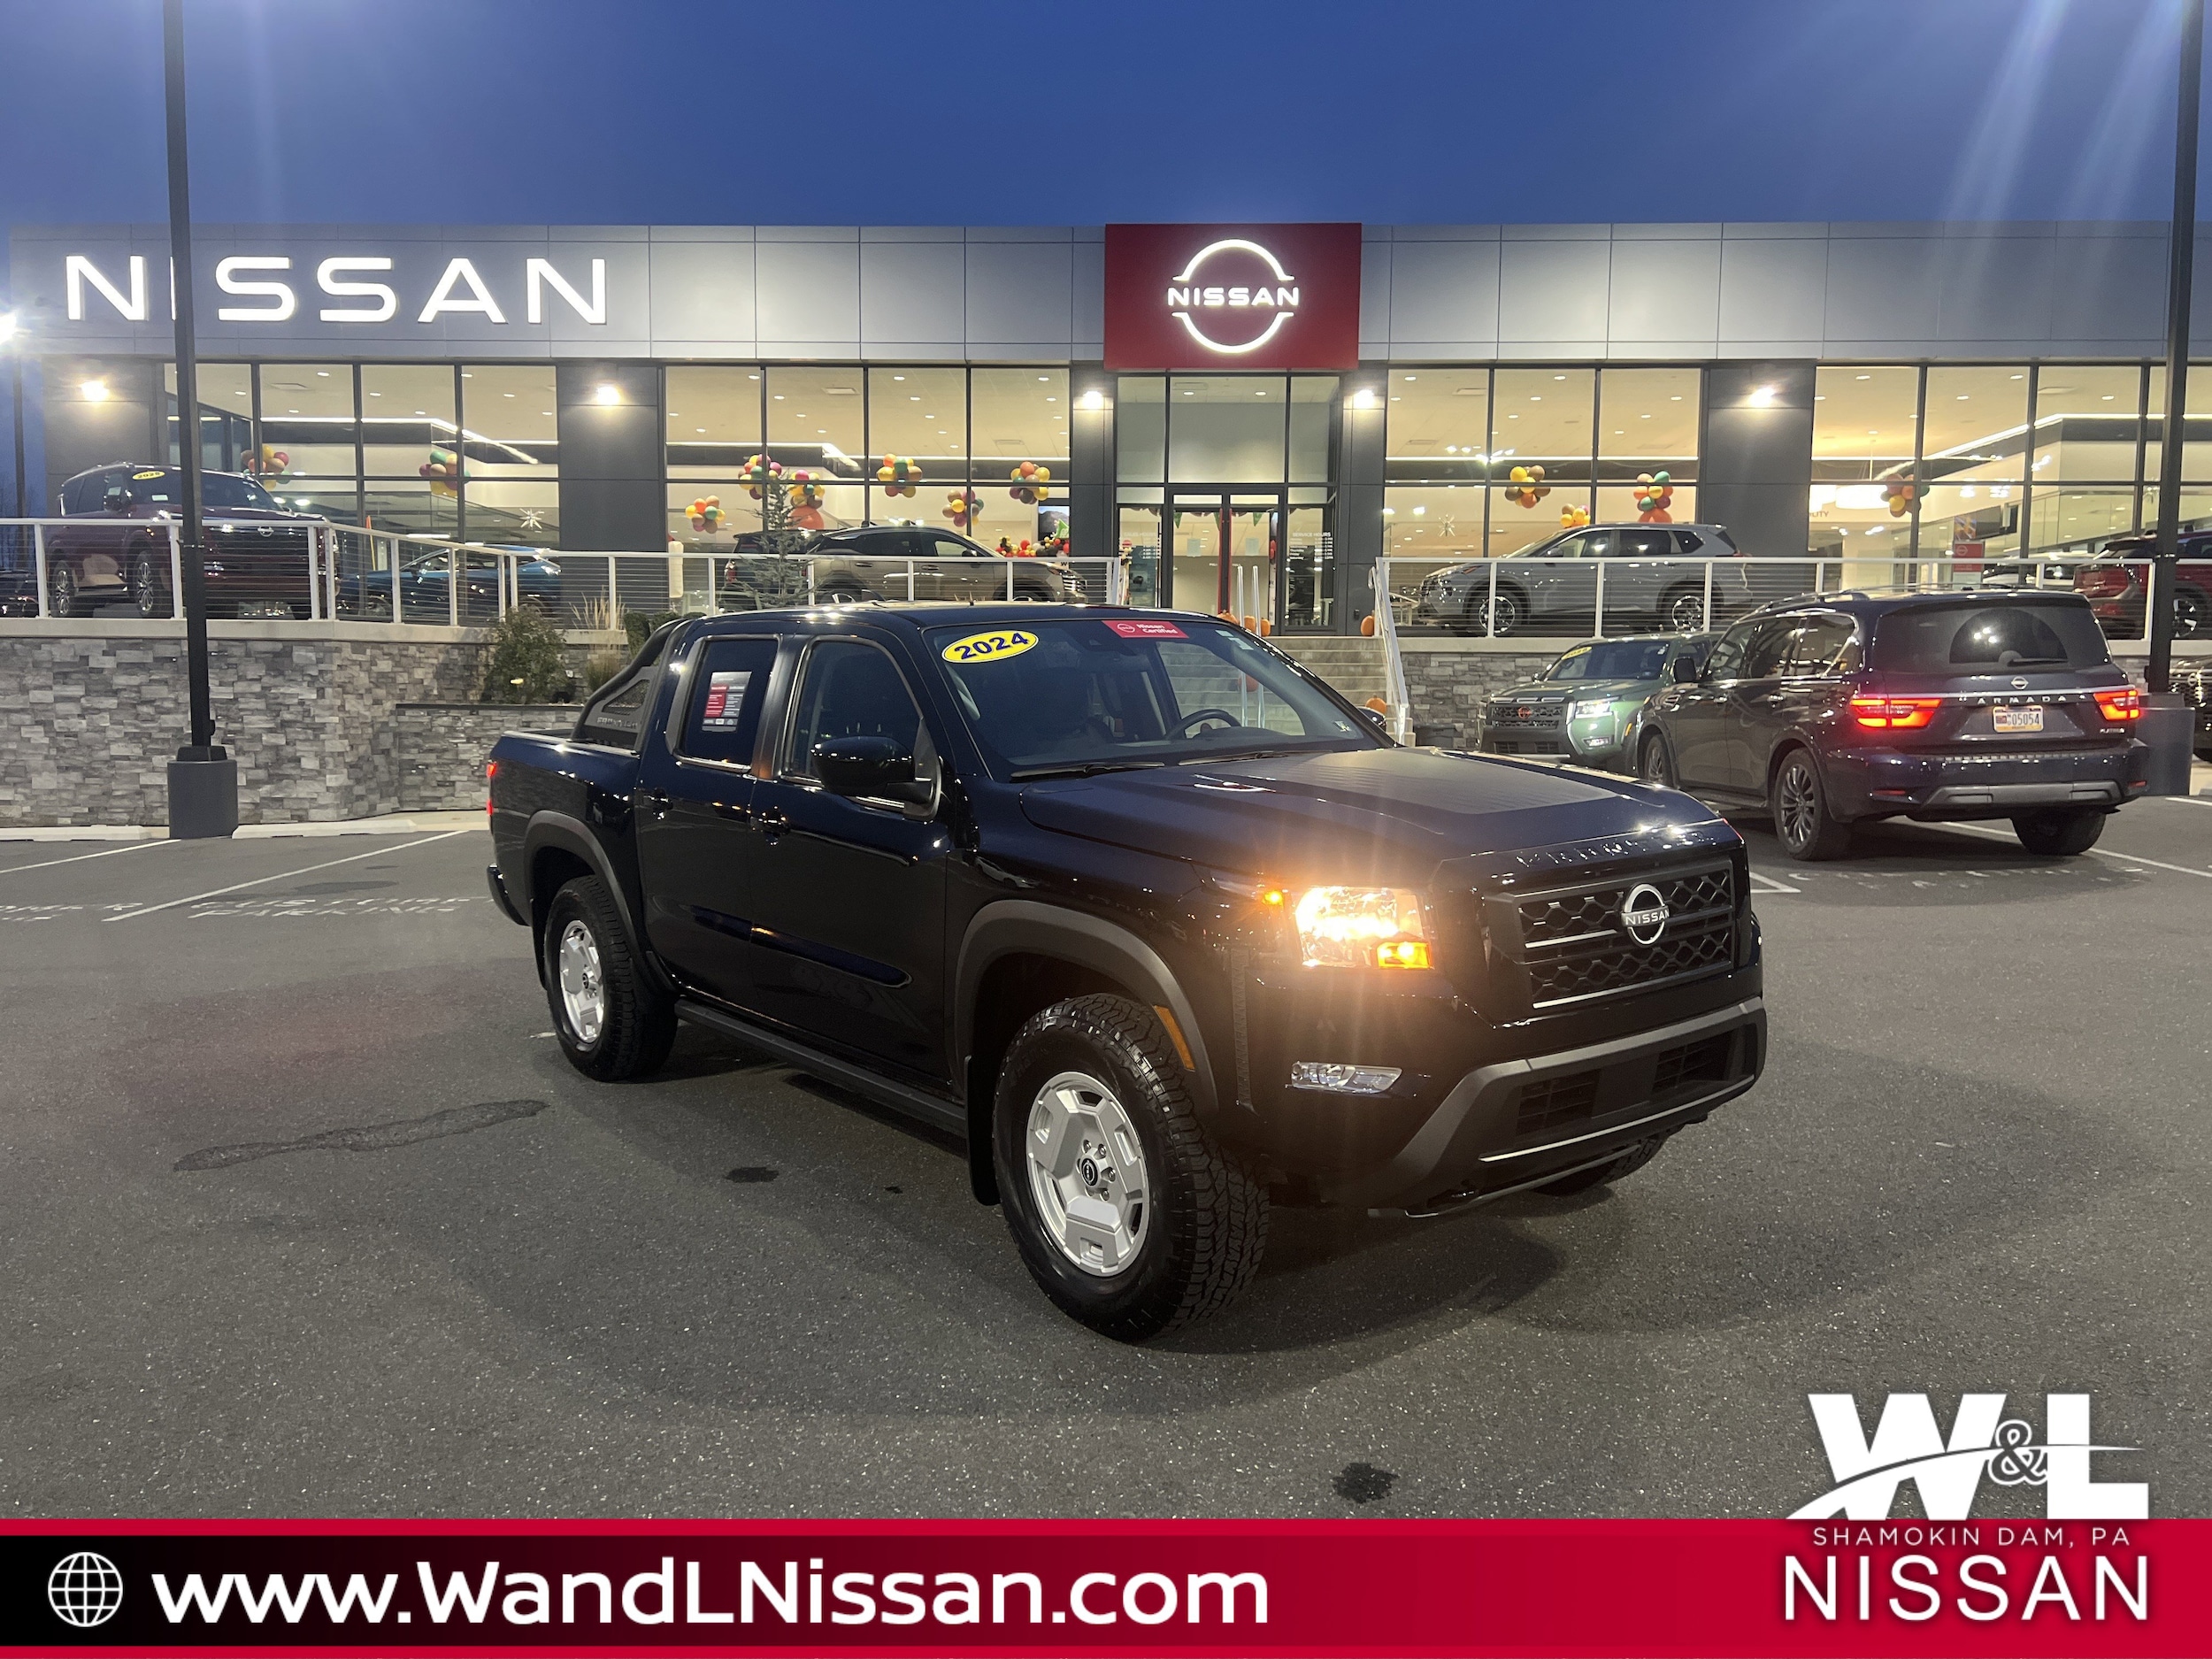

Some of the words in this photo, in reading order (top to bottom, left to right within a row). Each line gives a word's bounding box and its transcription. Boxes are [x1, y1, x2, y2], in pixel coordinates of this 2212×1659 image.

[66, 256, 607, 324] NSSAN
[1167, 287, 1300, 306] NISSAN
[954, 633, 1028, 659] 2024
[1977, 695, 2067, 705] ARMADA
[2011, 713, 2039, 726] 05054
[1625, 906, 1670, 926] NISSAN
